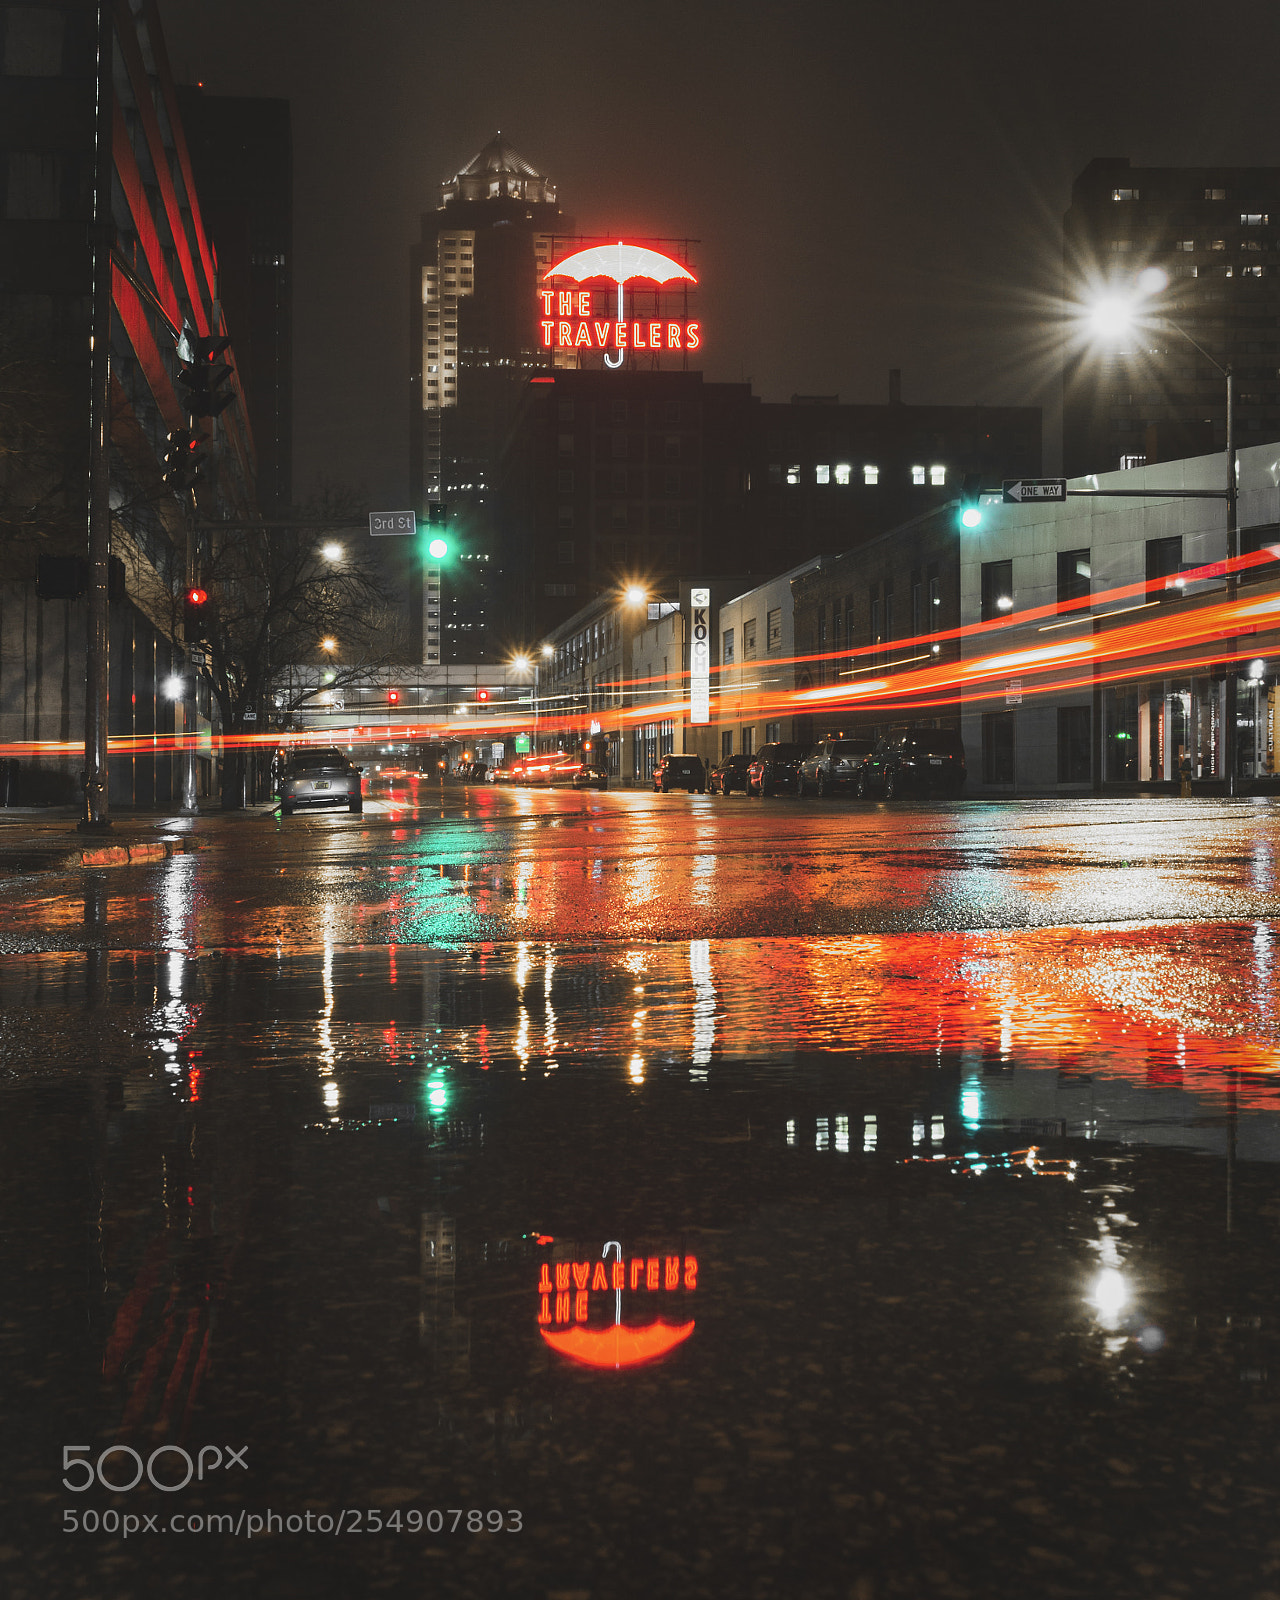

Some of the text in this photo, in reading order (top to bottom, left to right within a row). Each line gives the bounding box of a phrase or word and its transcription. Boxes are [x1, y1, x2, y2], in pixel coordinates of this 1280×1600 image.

[541, 290, 591, 317] THE
[541, 321, 700, 349] TRAVELERS
[1021, 486, 1059, 496] ONE WAY
[374, 516, 411, 530] 3rd St
[694, 608, 707, 672] KOCH
